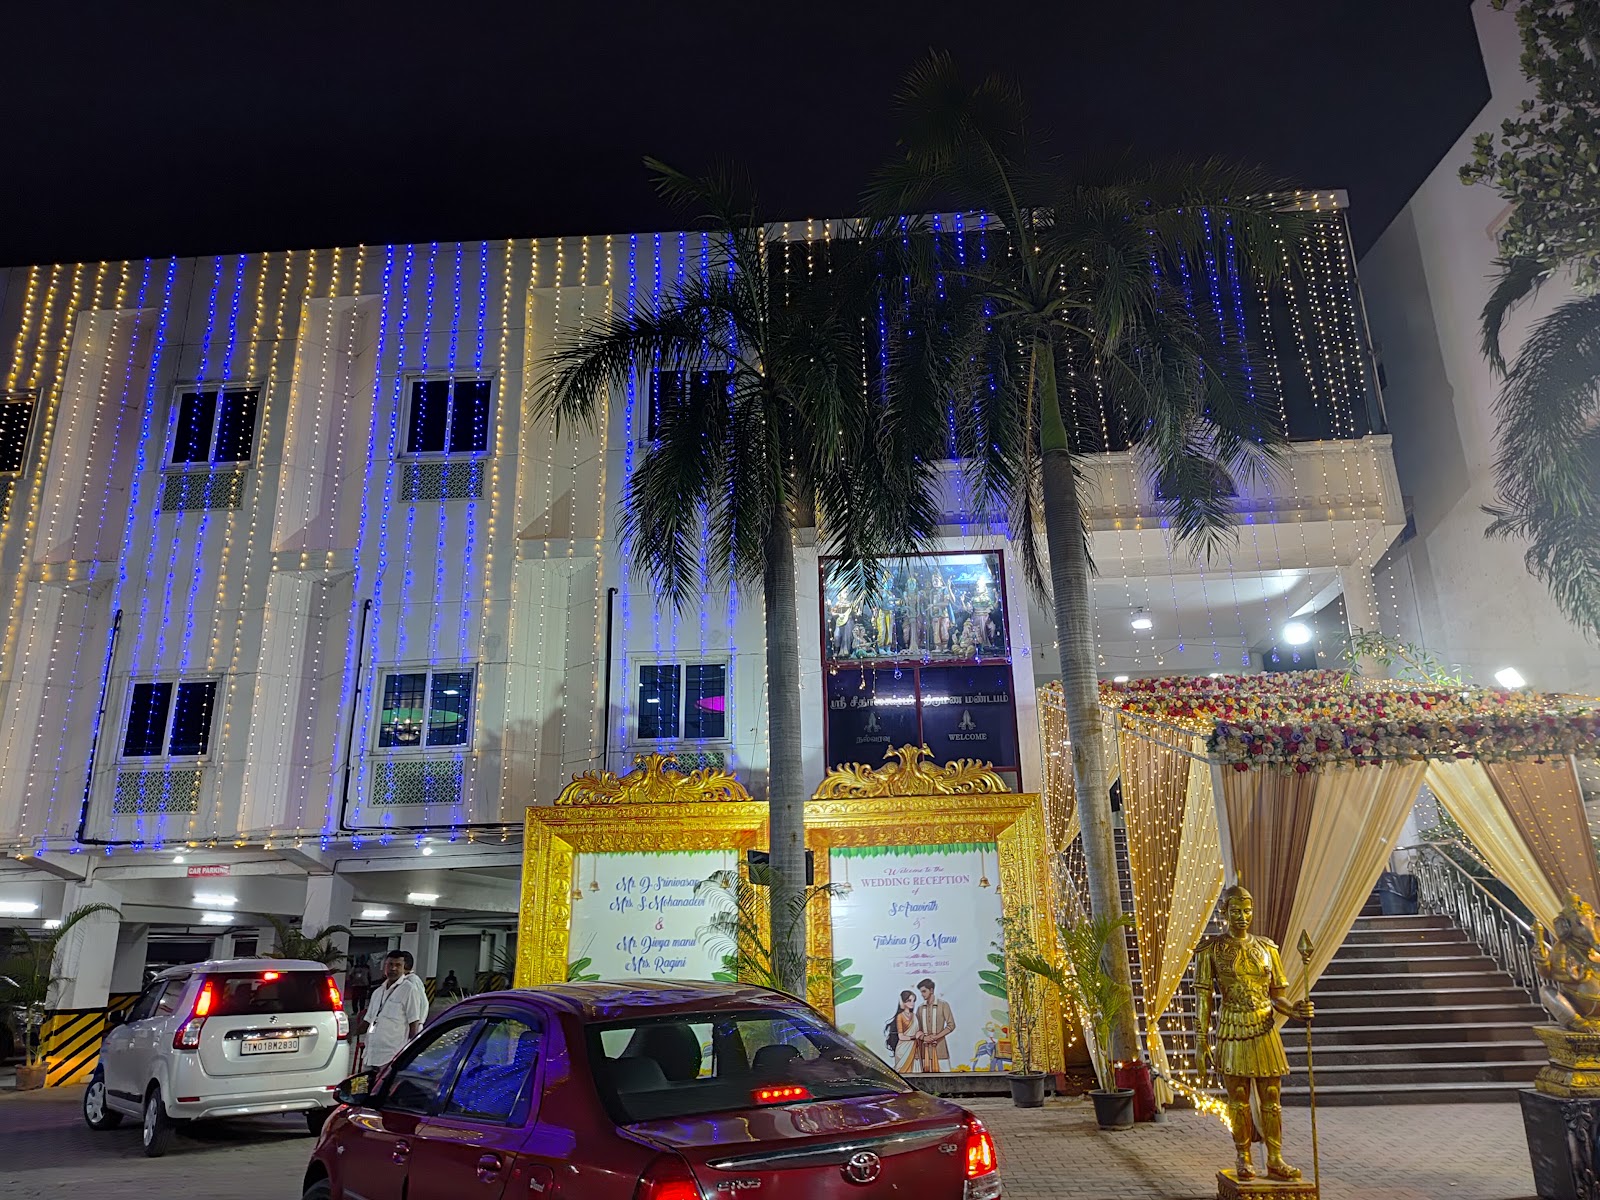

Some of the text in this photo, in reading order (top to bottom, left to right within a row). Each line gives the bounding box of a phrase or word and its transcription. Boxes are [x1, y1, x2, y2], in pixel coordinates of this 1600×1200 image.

[965, 691, 1008, 704] மண்டபம்
[948, 733, 988, 741] WELCOME
[188, 867, 201, 875] CAR
[884, 866, 922, 875] Welcome
[860, 874, 970, 888] WEDDING RECEPTION
[654, 956, 687, 974] Ragini
